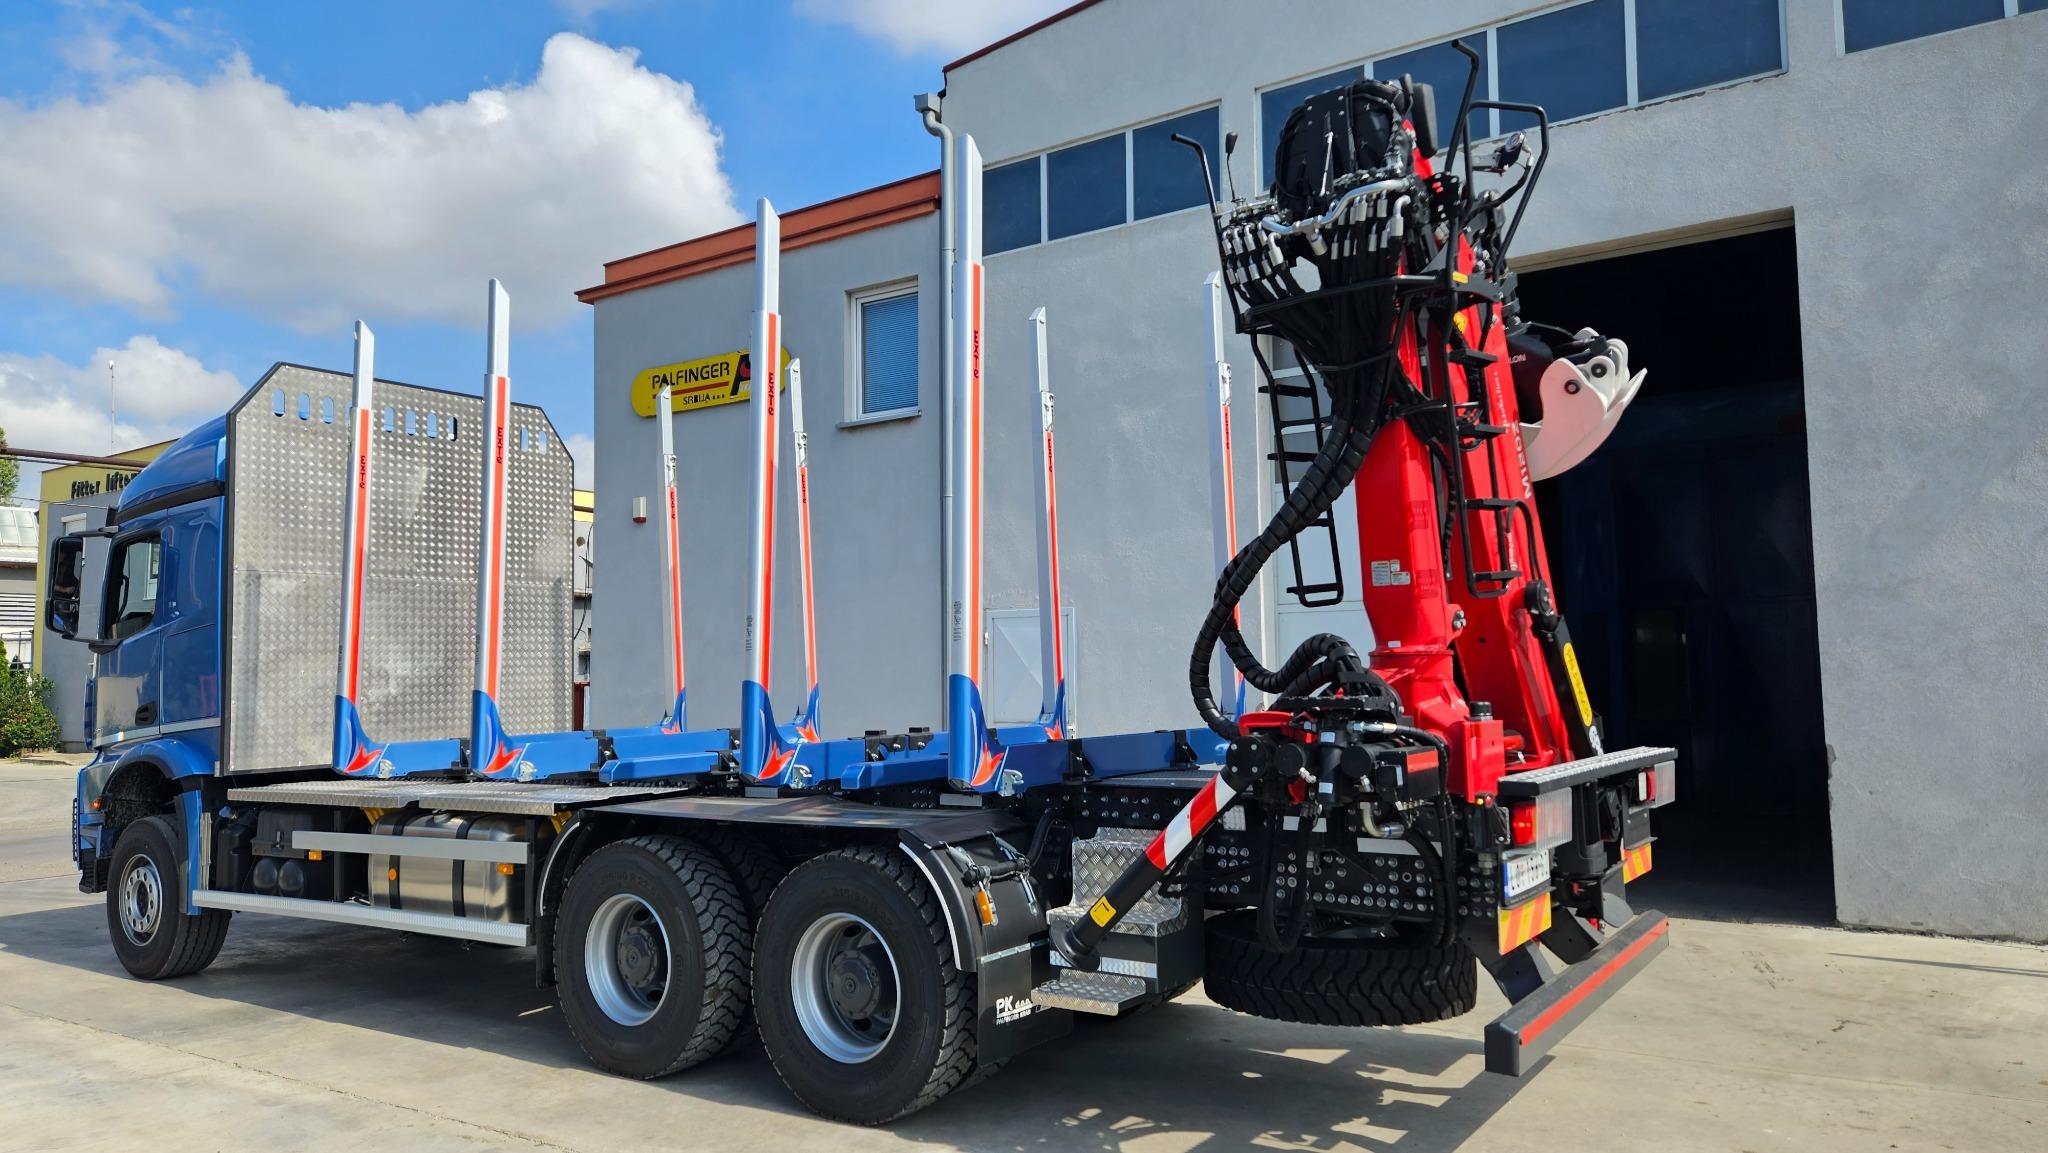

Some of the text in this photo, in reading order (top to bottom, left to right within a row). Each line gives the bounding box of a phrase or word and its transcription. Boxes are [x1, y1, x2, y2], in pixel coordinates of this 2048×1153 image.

[652, 361, 730, 390] PALFINGER
[683, 392, 711, 405] SRBIJA
[996, 995, 1014, 1017] PK
